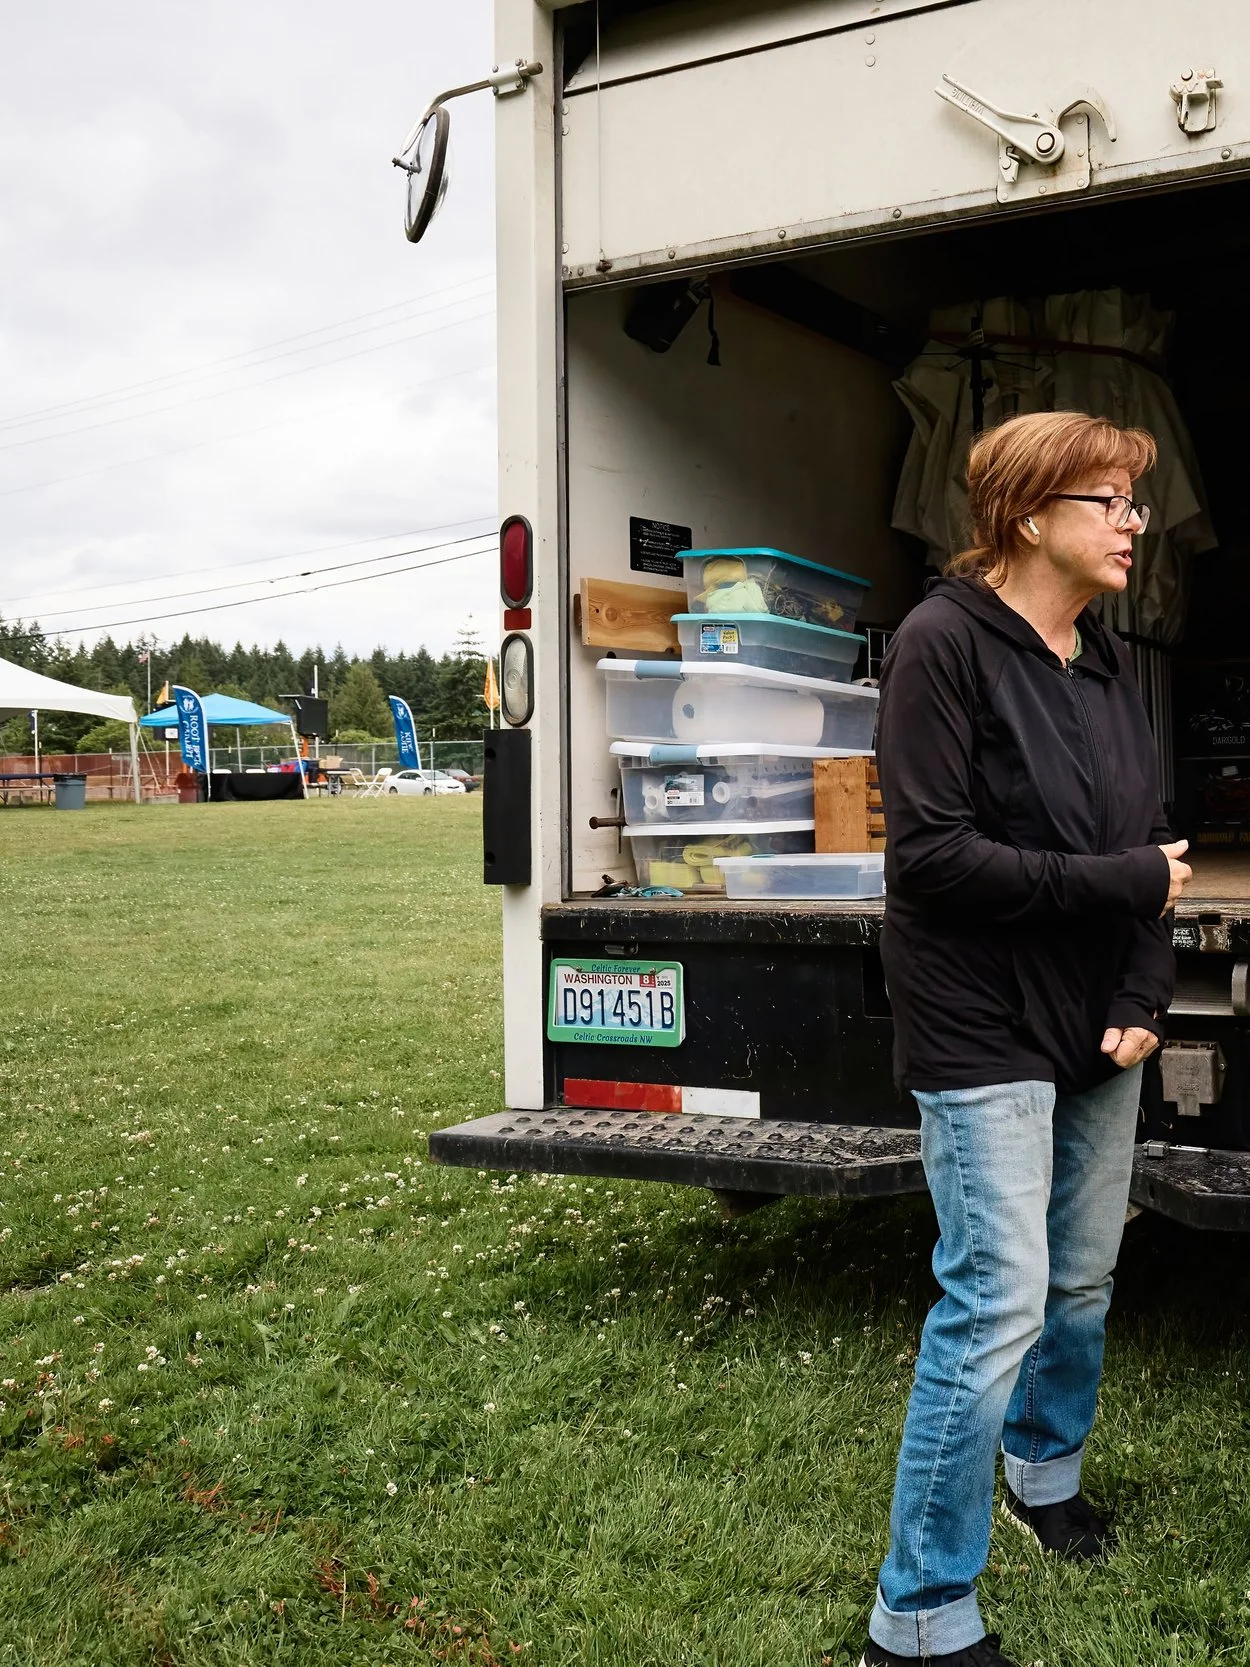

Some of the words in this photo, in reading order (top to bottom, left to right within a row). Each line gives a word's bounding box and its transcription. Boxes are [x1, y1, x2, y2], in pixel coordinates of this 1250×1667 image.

[190, 715, 200, 743] ROOT
[1212, 735, 1246, 744] DARIGOLD
[591, 963, 612, 973] Celtic
[614, 964, 641, 973] Forever
[564, 973, 633, 985] WASHINGTON
[643, 974, 650, 984] 8
[563, 987, 675, 1029] D91451B
[573, 1032, 595, 1041] Celtic
[596, 1033, 638, 1043] Crossroads
[640, 1035, 653, 1044] NW
